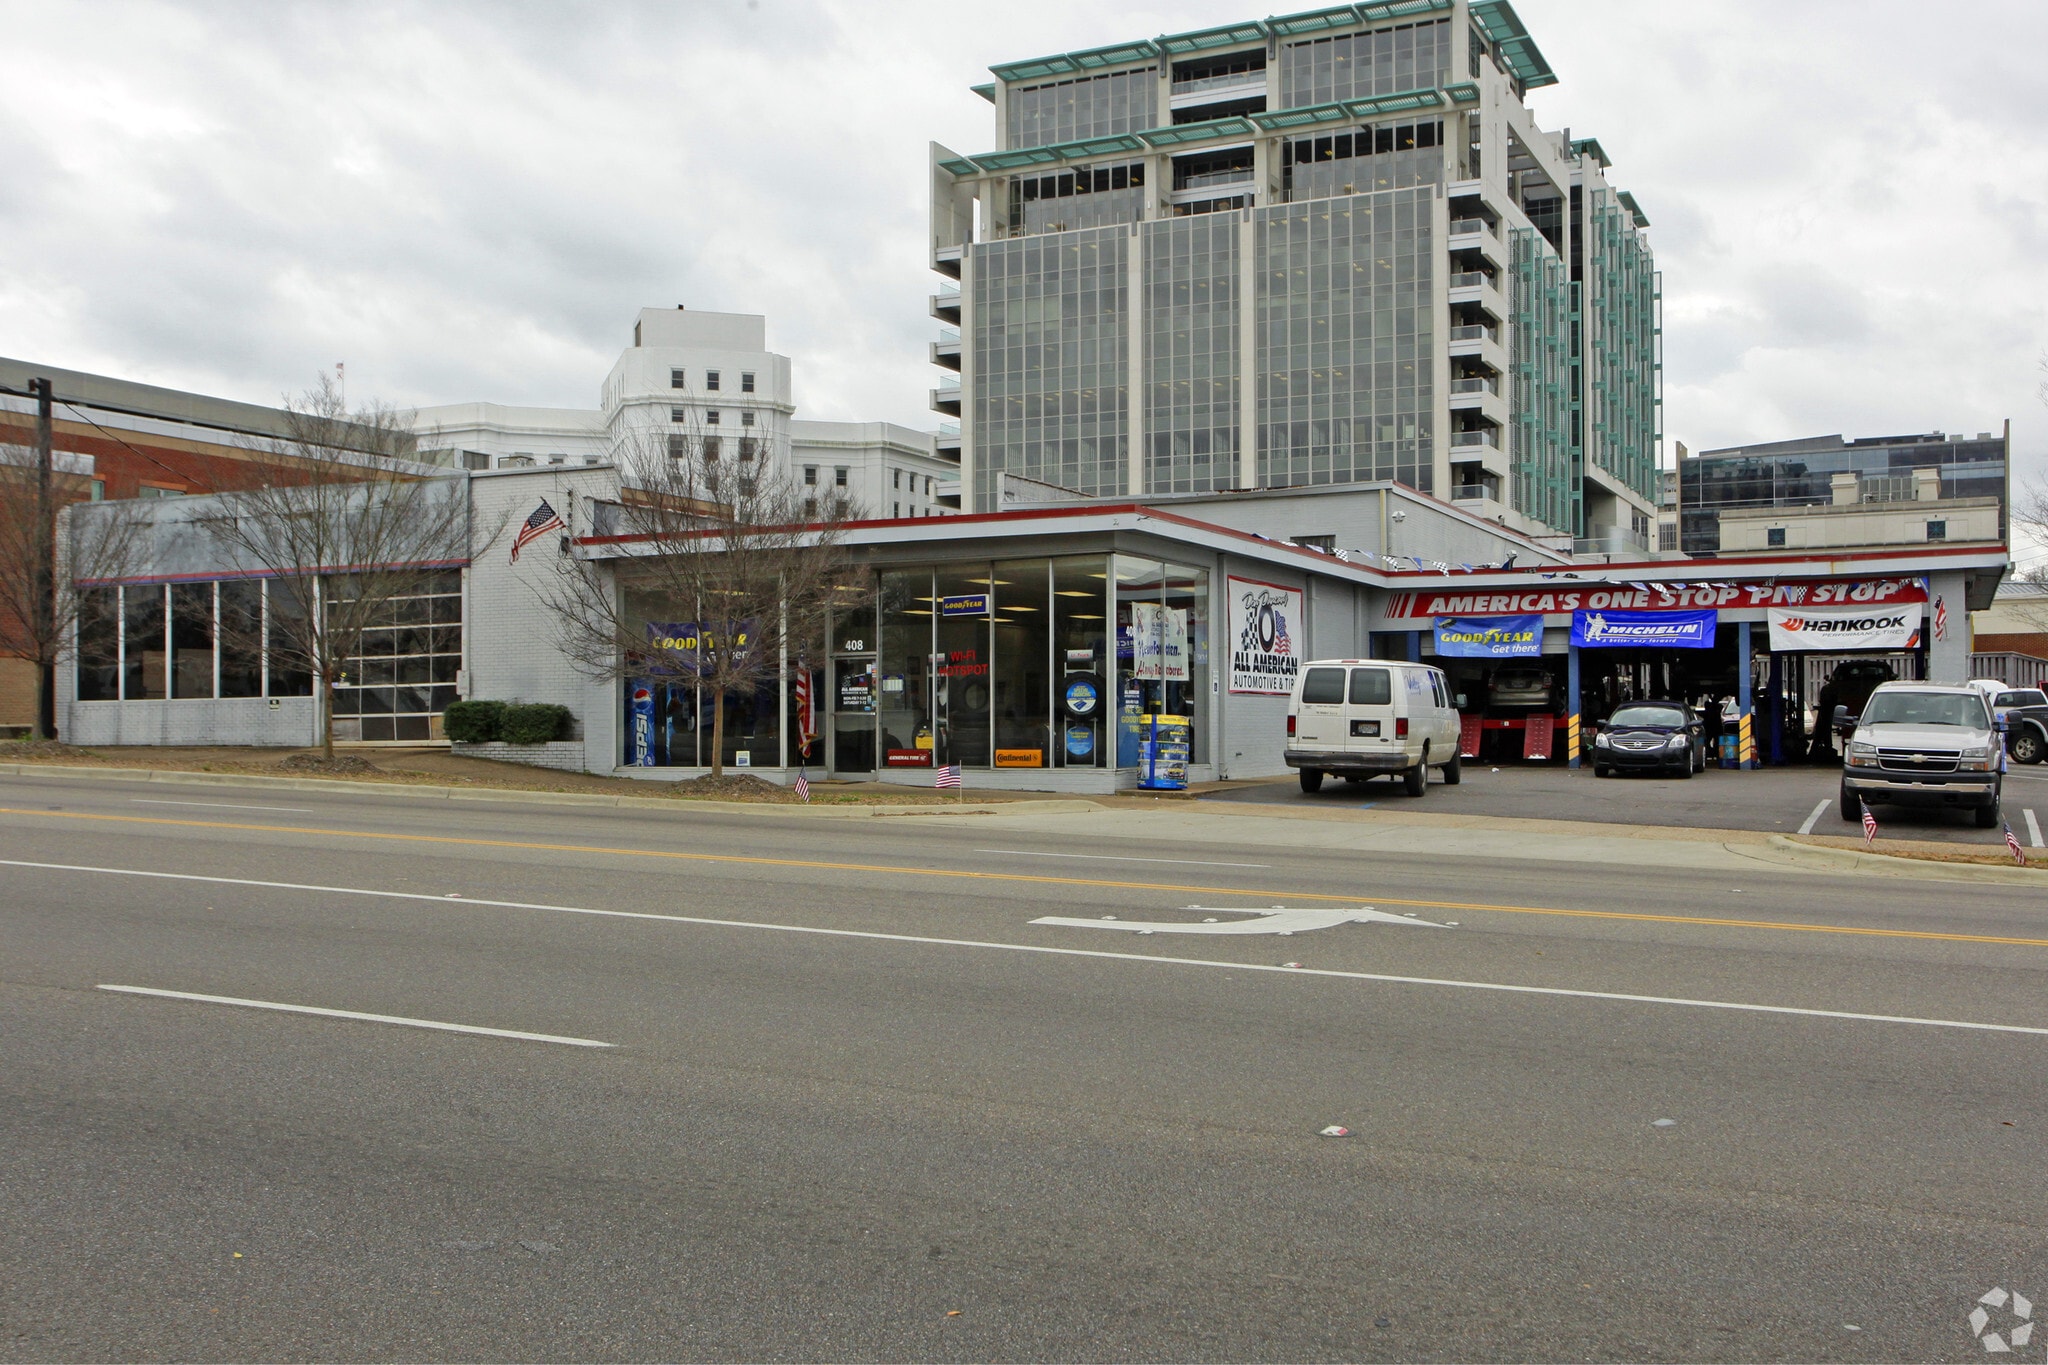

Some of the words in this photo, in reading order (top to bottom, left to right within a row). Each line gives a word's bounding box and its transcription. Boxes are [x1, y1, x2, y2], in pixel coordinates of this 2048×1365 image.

[944, 599, 983, 610] GOODYEAR
[1426, 593, 1580, 614] AMERICA'S
[1588, 591, 1649, 609] ONE
[1658, 588, 1740, 607] STOP
[1607, 624, 1698, 635] MICHELIN
[1440, 629, 1534, 645] GOODYEAR
[845, 640, 864, 651] 408
[1492, 644, 1510, 654] Get
[1512, 644, 1538, 653] there
[950, 649, 977, 662] WI-FI
[1234, 651, 1250, 672] ALL
[1253, 654, 1298, 676] AMERICAN
[939, 664, 989, 677] HOTSPOT
[1234, 675, 1277, 690] AUTOMOTIVE
[1279, 678, 1283, 690] &
[1285, 678, 1295, 690] TIR
[997, 754, 1032, 763] Continental
